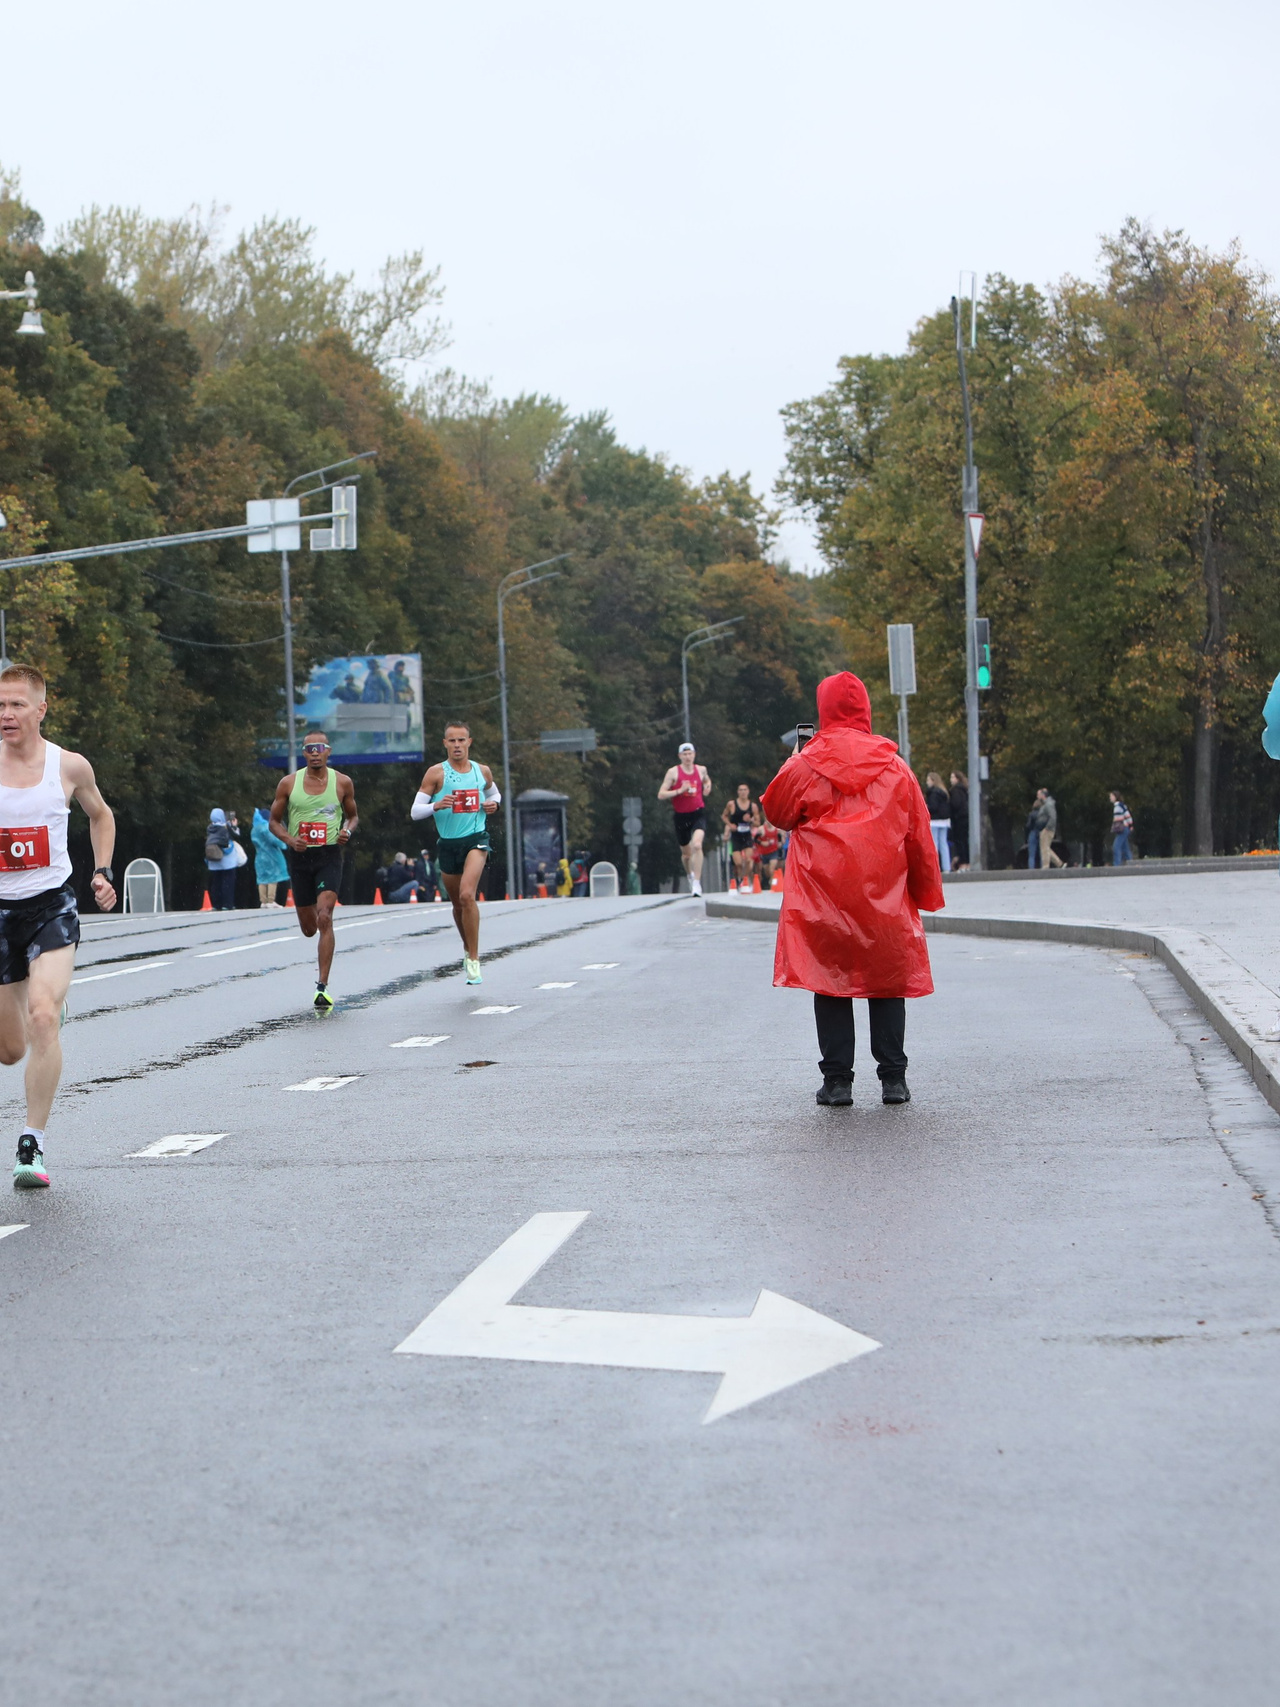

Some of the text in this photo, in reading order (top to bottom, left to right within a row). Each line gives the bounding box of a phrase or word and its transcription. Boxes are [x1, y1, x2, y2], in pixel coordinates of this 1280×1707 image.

[465, 797, 477, 806] 21
[309, 830, 325, 839] 05
[10, 840, 35, 858] 01
